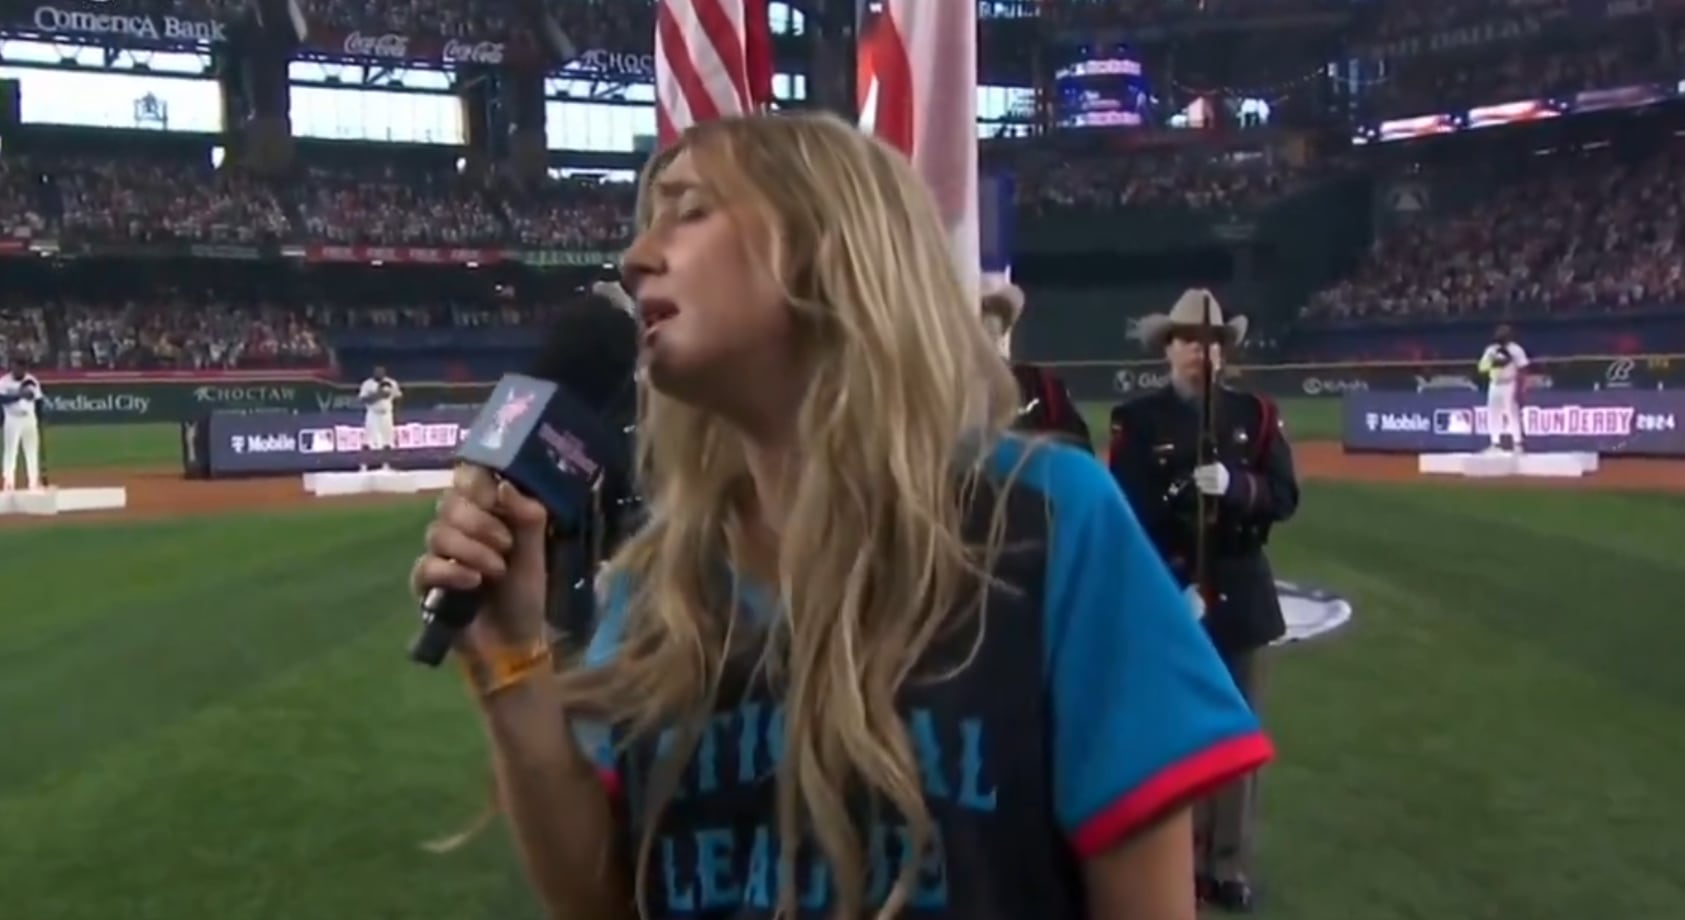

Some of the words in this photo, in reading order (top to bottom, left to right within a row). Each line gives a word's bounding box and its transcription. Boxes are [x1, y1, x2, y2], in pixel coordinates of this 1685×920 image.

[164, 16, 228, 41] Bank
[42, 394, 112, 412] Medical
[115, 394, 151, 414] City
[1381, 412, 1431, 431] Mobile
[1636, 413, 1675, 430] 2024
[247, 434, 296, 452] Mobile
